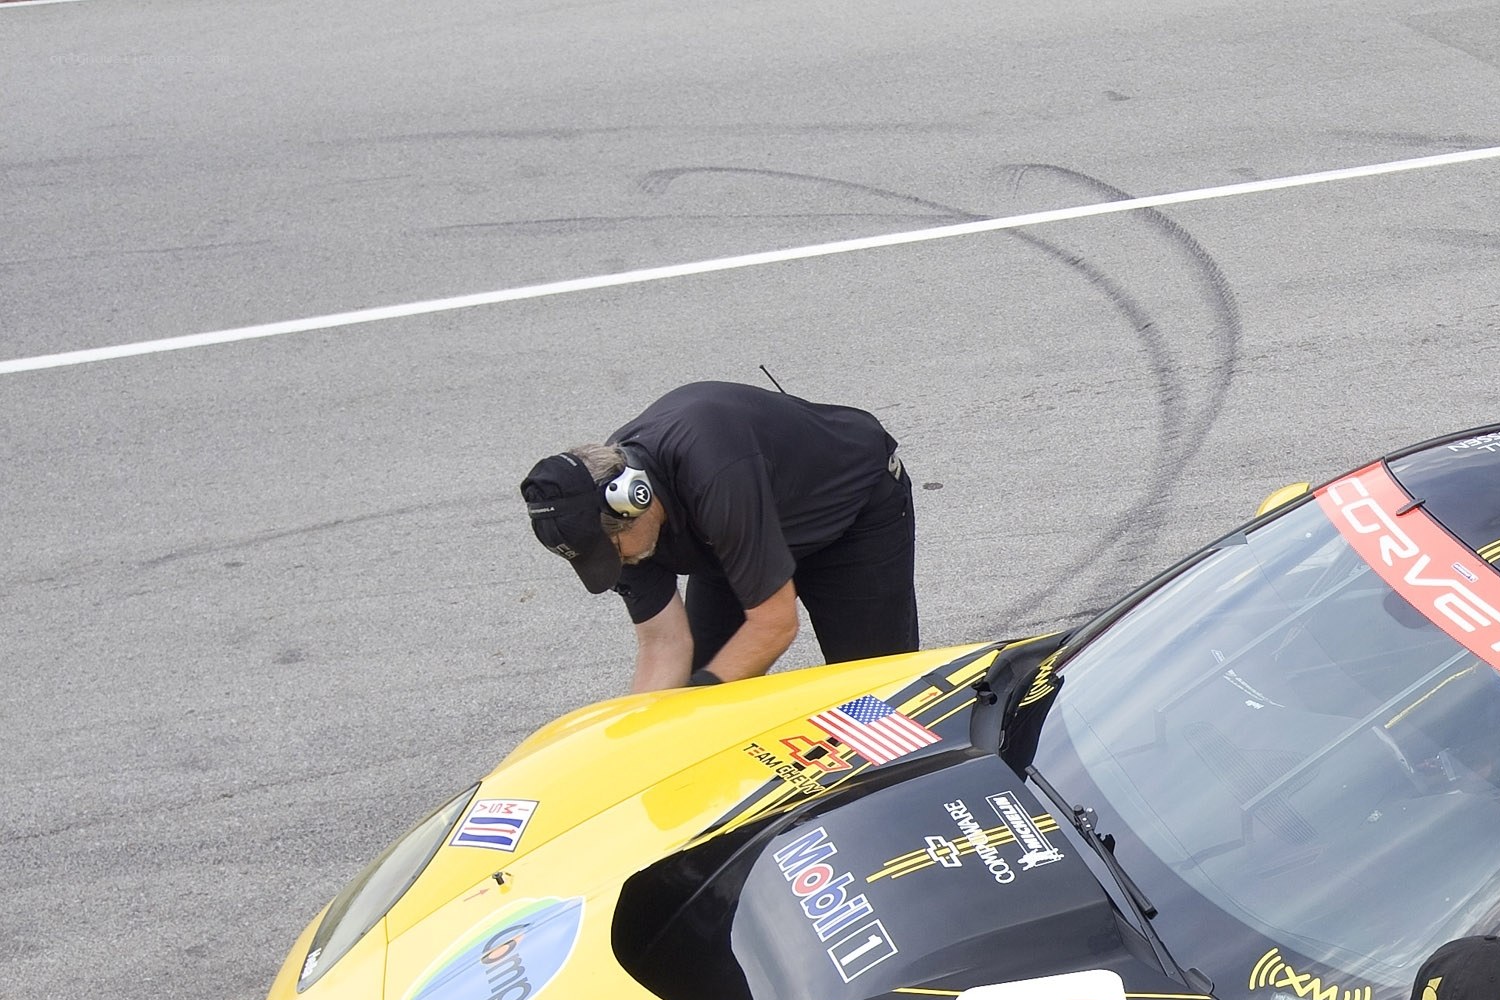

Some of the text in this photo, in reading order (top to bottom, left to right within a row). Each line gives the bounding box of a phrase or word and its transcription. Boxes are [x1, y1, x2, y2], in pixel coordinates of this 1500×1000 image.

[743, 742, 825, 794] TEAM CHEVY
[944, 799, 1016, 884] COMPUWARE
[993, 796, 1043, 851] MICHELIN
[773, 826, 884, 968] Mobil 1
